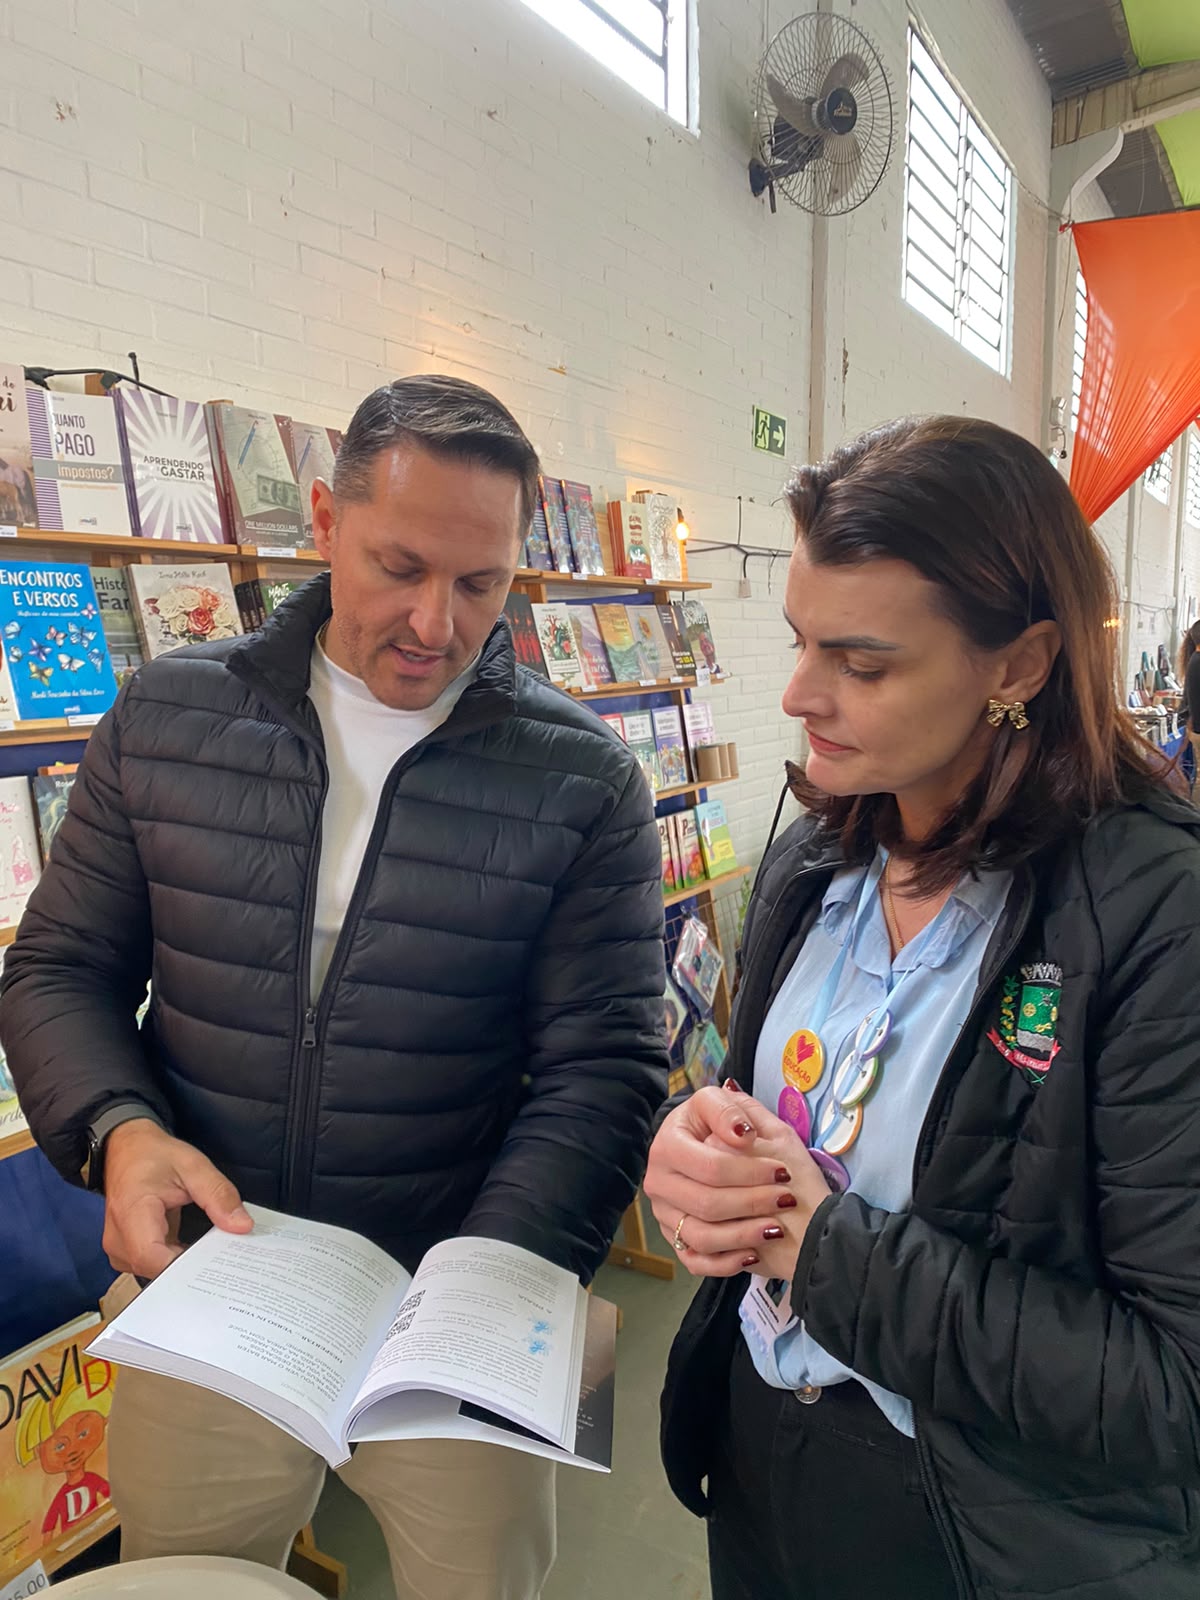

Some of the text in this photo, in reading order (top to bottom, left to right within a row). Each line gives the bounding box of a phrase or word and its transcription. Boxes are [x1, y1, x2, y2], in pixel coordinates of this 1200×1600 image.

[53, 413, 86, 429] UANTO
[55, 432, 96, 456] PAGO
[143, 455, 205, 471] APRENDENDO
[160, 466, 205, 481] GASTAR
[0, 569, 83, 589] ENCONTROS
[12, 590, 79, 608] E VERSOS
[65, 1486, 90, 1523] D
